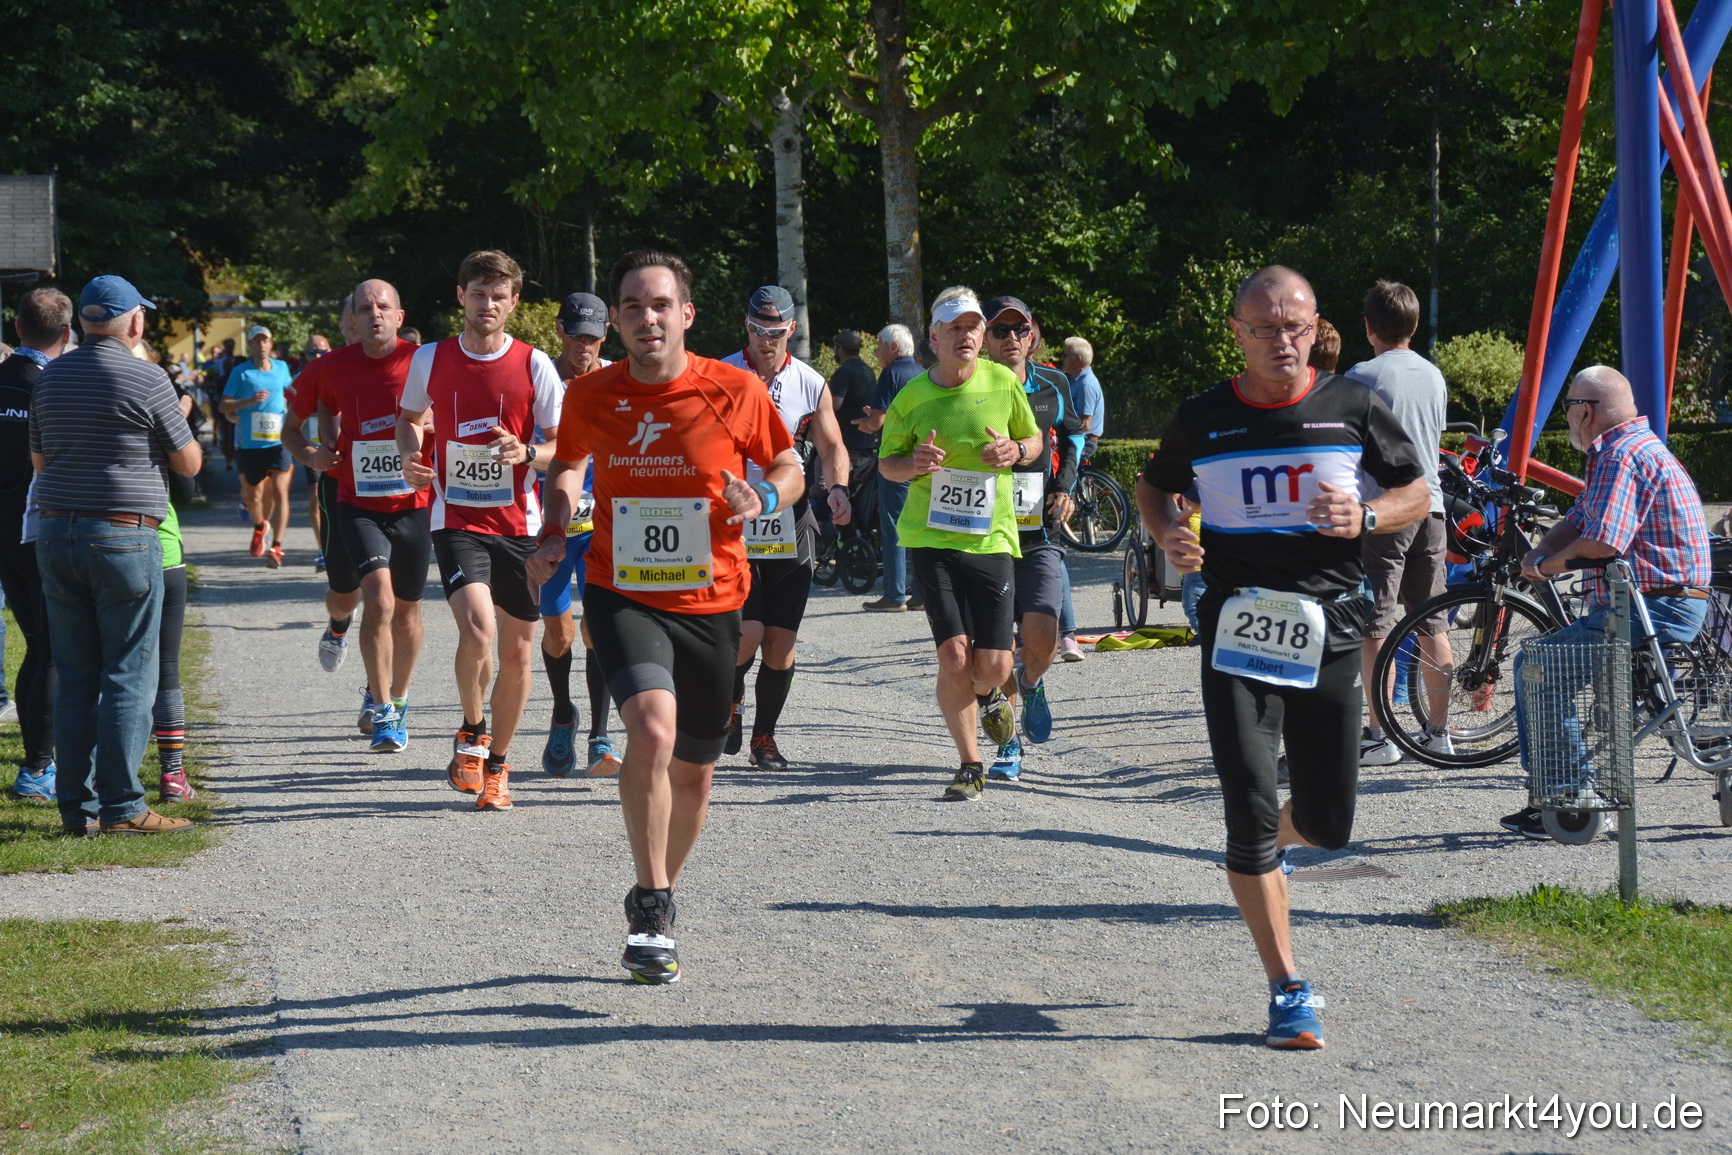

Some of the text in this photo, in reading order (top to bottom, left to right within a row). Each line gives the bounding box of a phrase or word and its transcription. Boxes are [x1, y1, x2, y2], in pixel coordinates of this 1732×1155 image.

[259, 421, 275, 430] 133
[370, 420, 387, 429] DEHN
[469, 422, 487, 431] DEHN
[360, 455, 403, 473] 2466
[608, 454, 684, 468] funrunners
[455, 460, 502, 481] 2459
[630, 465, 697, 477] neumarkt
[950, 474, 979, 483] BOCK
[1241, 463, 1314, 505] mr
[367, 482, 401, 490] Johannes
[466, 491, 492, 500] Tobias
[940, 485, 986, 508] 2512
[640, 507, 682, 517] BOCK
[750, 518, 782, 536] 176
[950, 516, 970, 526] Erich
[644, 525, 679, 552] 80
[639, 569, 685, 581] Michael
[1255, 597, 1300, 613] BOCK
[1233, 612, 1310, 649] 2318
[1238, 642, 1290, 657] PARTL Neumarkt
[1246, 657, 1285, 675] Albert
